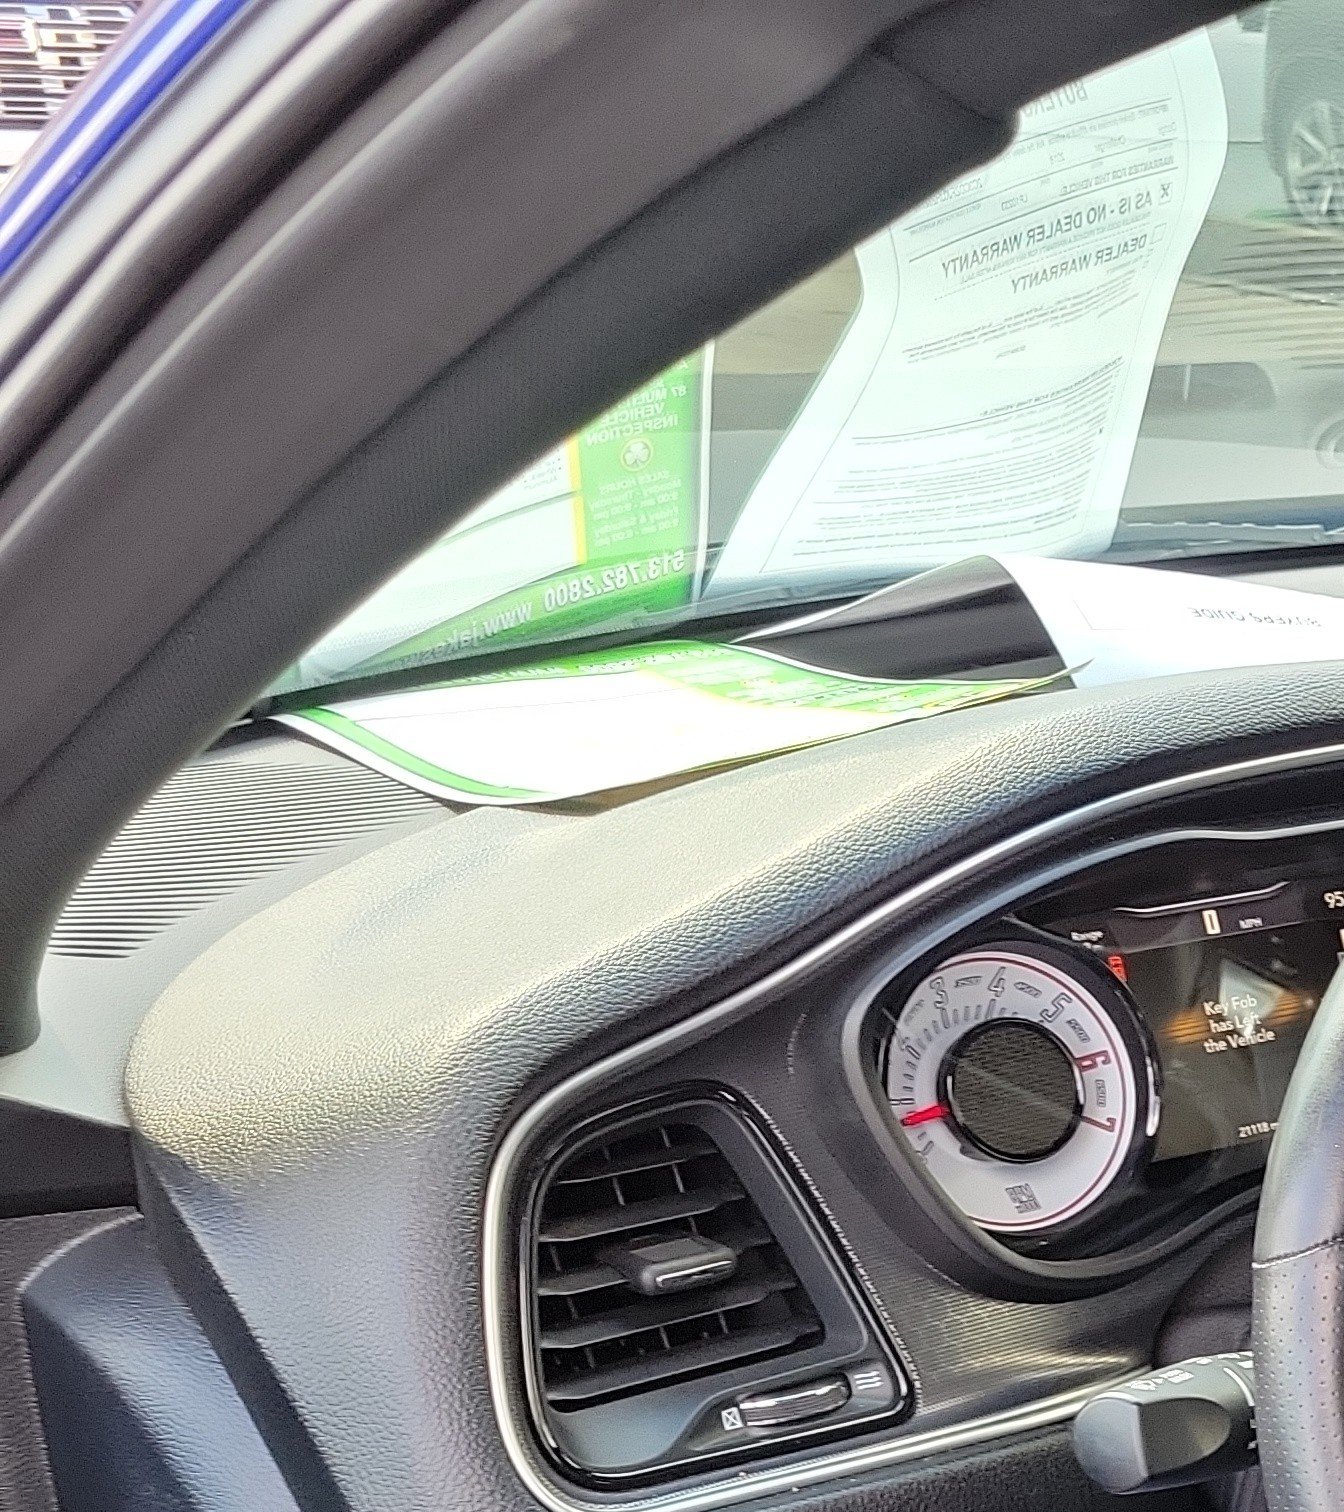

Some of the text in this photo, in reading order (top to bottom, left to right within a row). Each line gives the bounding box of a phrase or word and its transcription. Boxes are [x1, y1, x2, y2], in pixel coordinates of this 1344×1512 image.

[930, 976, 949, 1008] 3
[988, 965, 1007, 997] 4
[1040, 992, 1074, 1024] 5
[1202, 994, 1258, 1019] Key Fob
[1209, 1013, 1262, 1034] has Left
[1202, 1028, 1276, 1054] the Vehicle
[1075, 1049, 1112, 1074] 6
[1082, 1115, 1118, 1134] 7
